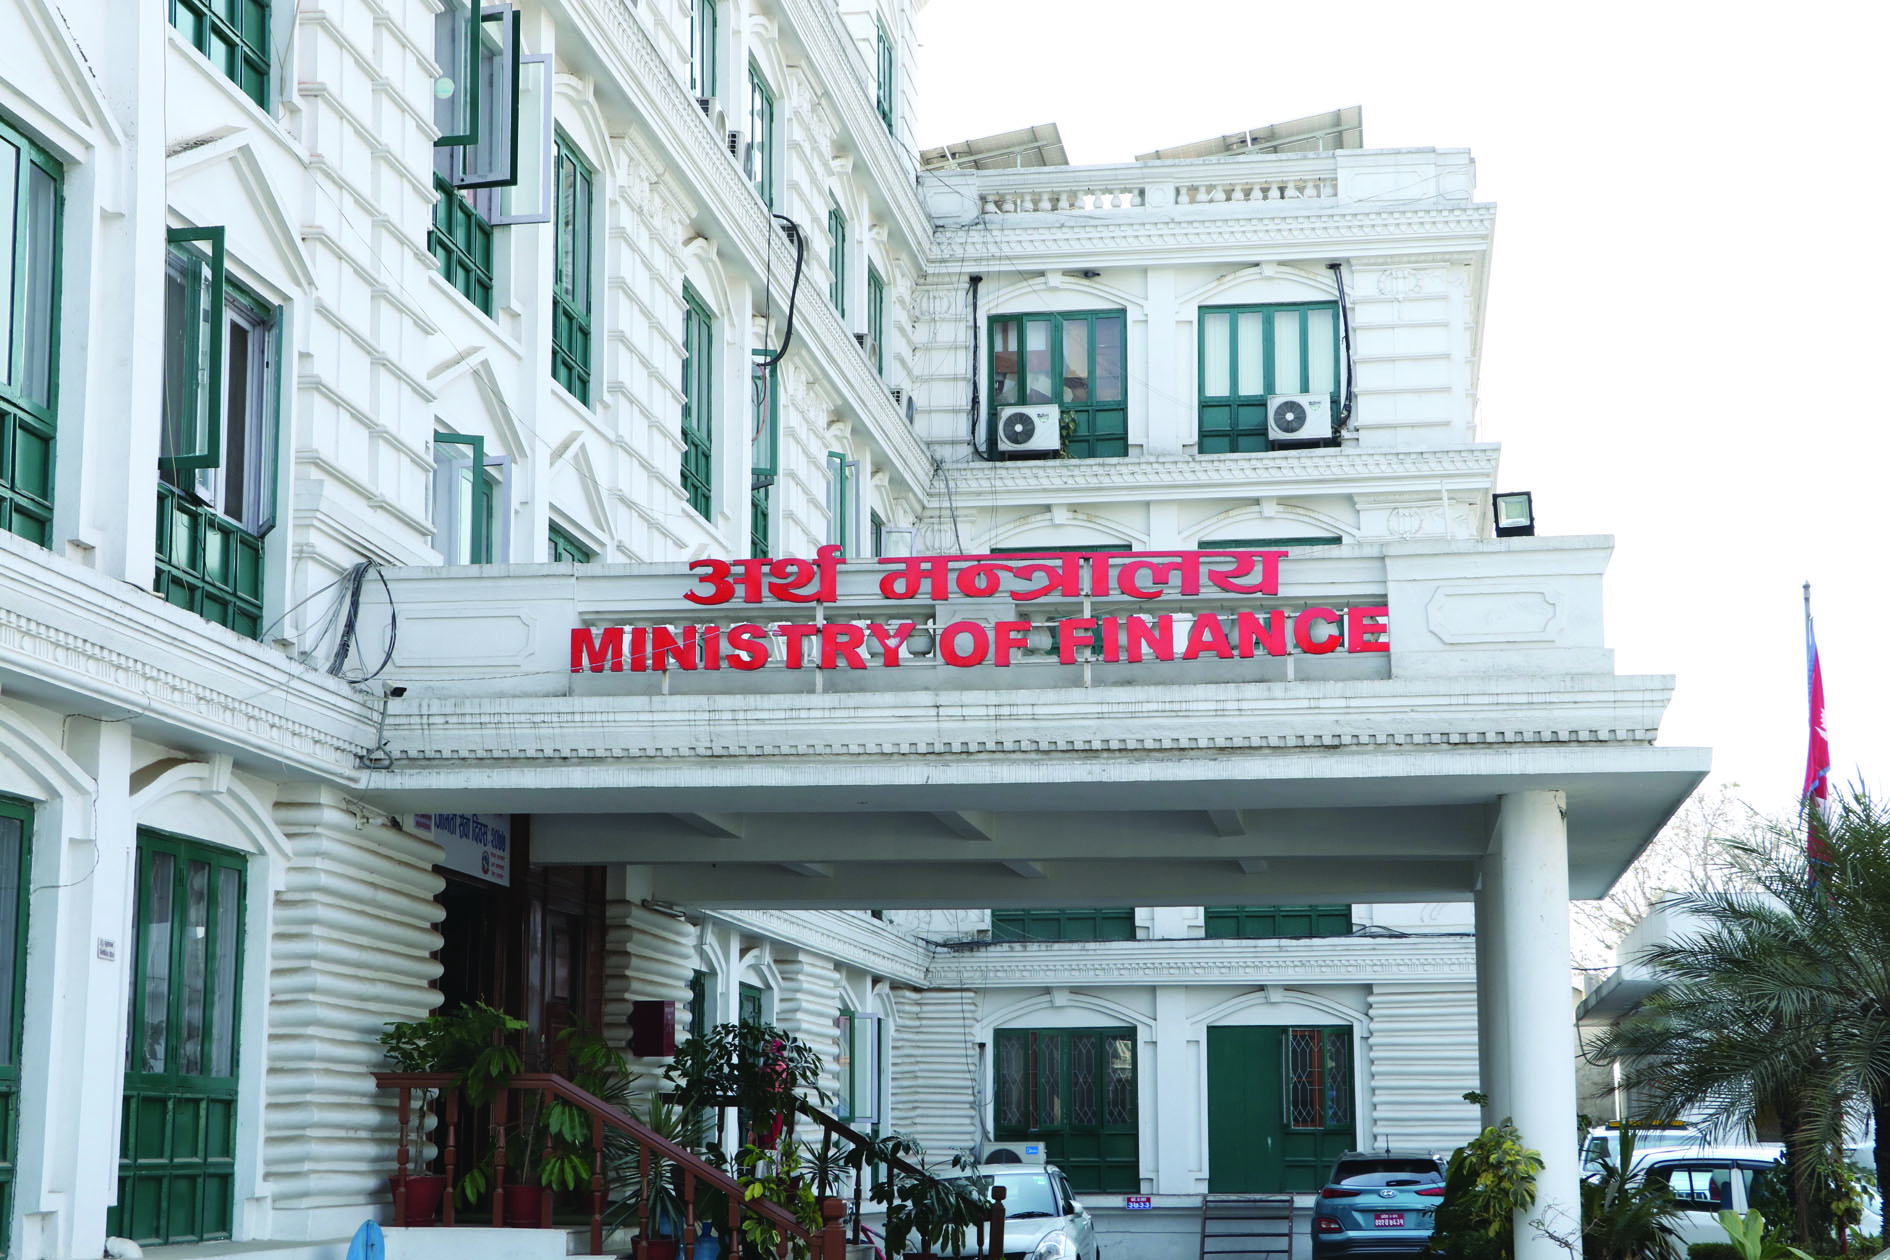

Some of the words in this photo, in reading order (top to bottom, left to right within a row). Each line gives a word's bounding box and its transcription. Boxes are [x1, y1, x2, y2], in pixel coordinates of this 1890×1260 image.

[683, 544, 847, 605] अर्थ
[877, 550, 1289, 601] मन्त्रालय
[570, 622, 917, 673] MINISTRY
[938, 620, 1032, 668] OF
[1058, 606, 1391, 665] FINANCE
